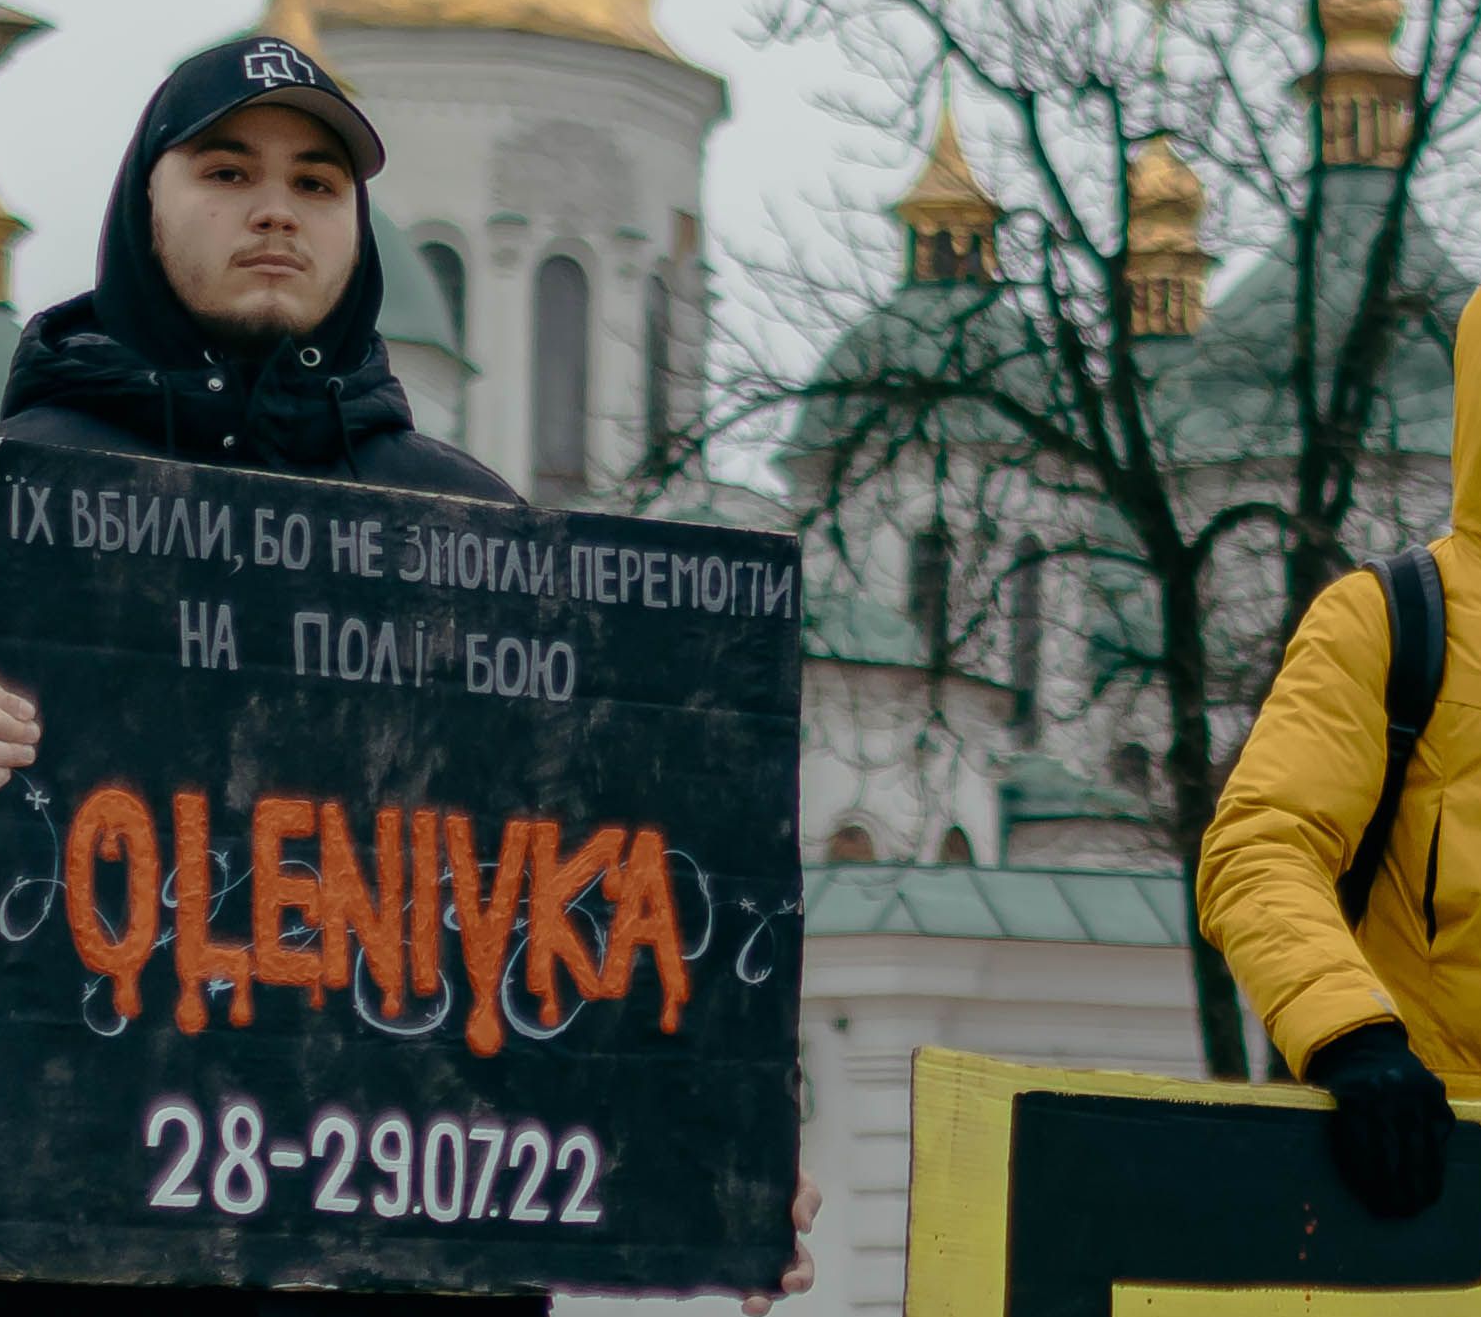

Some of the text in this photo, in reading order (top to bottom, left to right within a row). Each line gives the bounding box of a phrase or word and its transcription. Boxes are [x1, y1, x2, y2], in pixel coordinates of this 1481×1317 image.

[4, 474, 793, 620] ЇХ ВБИЛИ, БО НЕ ЗМОГЛИ ПЕРЕМОГТИ
[180, 600, 238, 671] НА
[465, 633, 576, 703] БОЮ
[64, 788, 691, 1058] OLENIVKA
